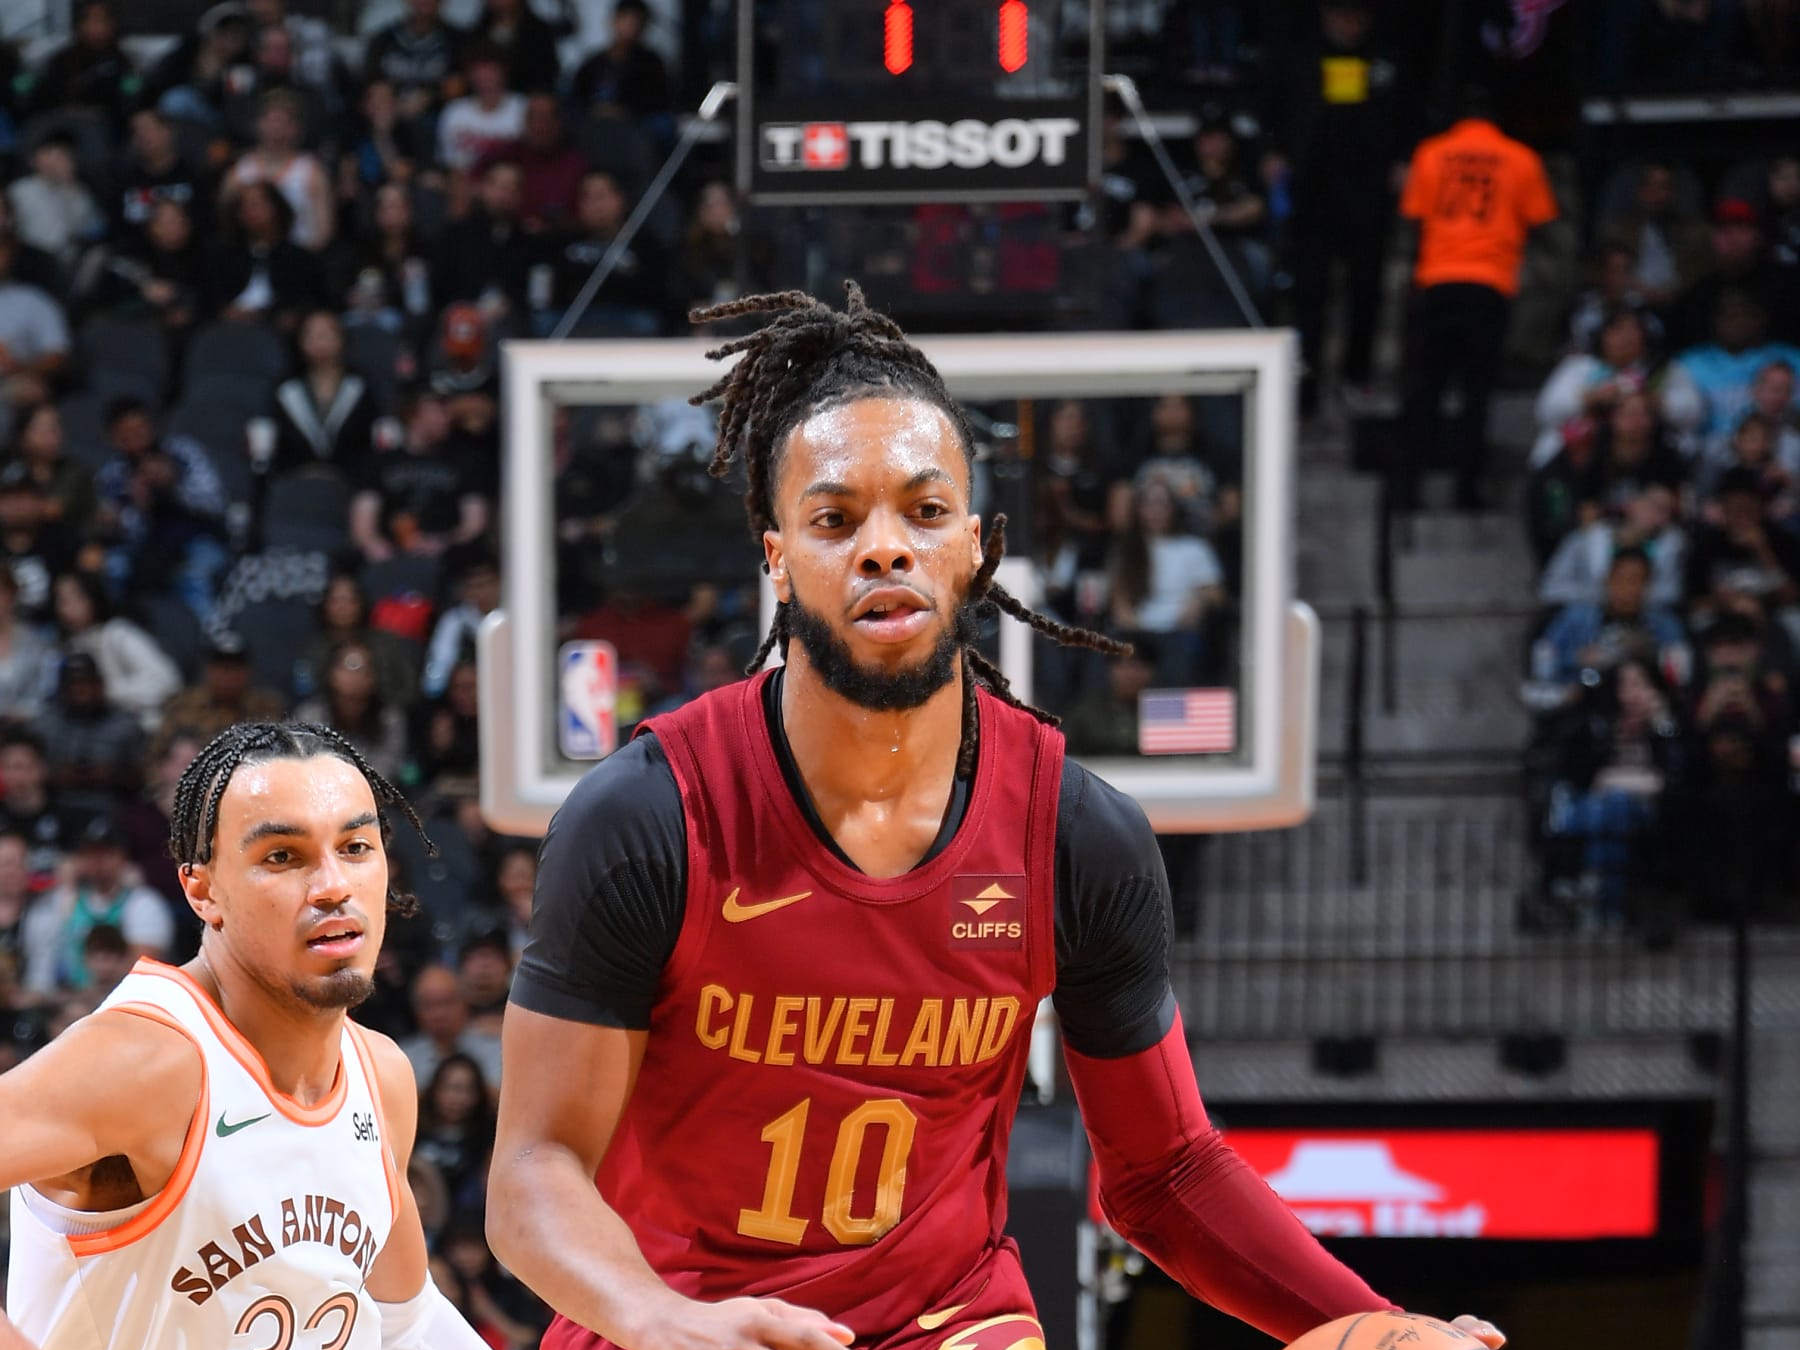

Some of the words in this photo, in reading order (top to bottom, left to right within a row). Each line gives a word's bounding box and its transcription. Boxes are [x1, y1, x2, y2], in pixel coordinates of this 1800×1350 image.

[848, 117, 1080, 170] TISSOT
[952, 922, 1021, 938] CLIFFS
[695, 984, 1020, 1067] CLEVELAND
[737, 1097, 917, 1245] 10
[171, 1213, 276, 1306] SAN
